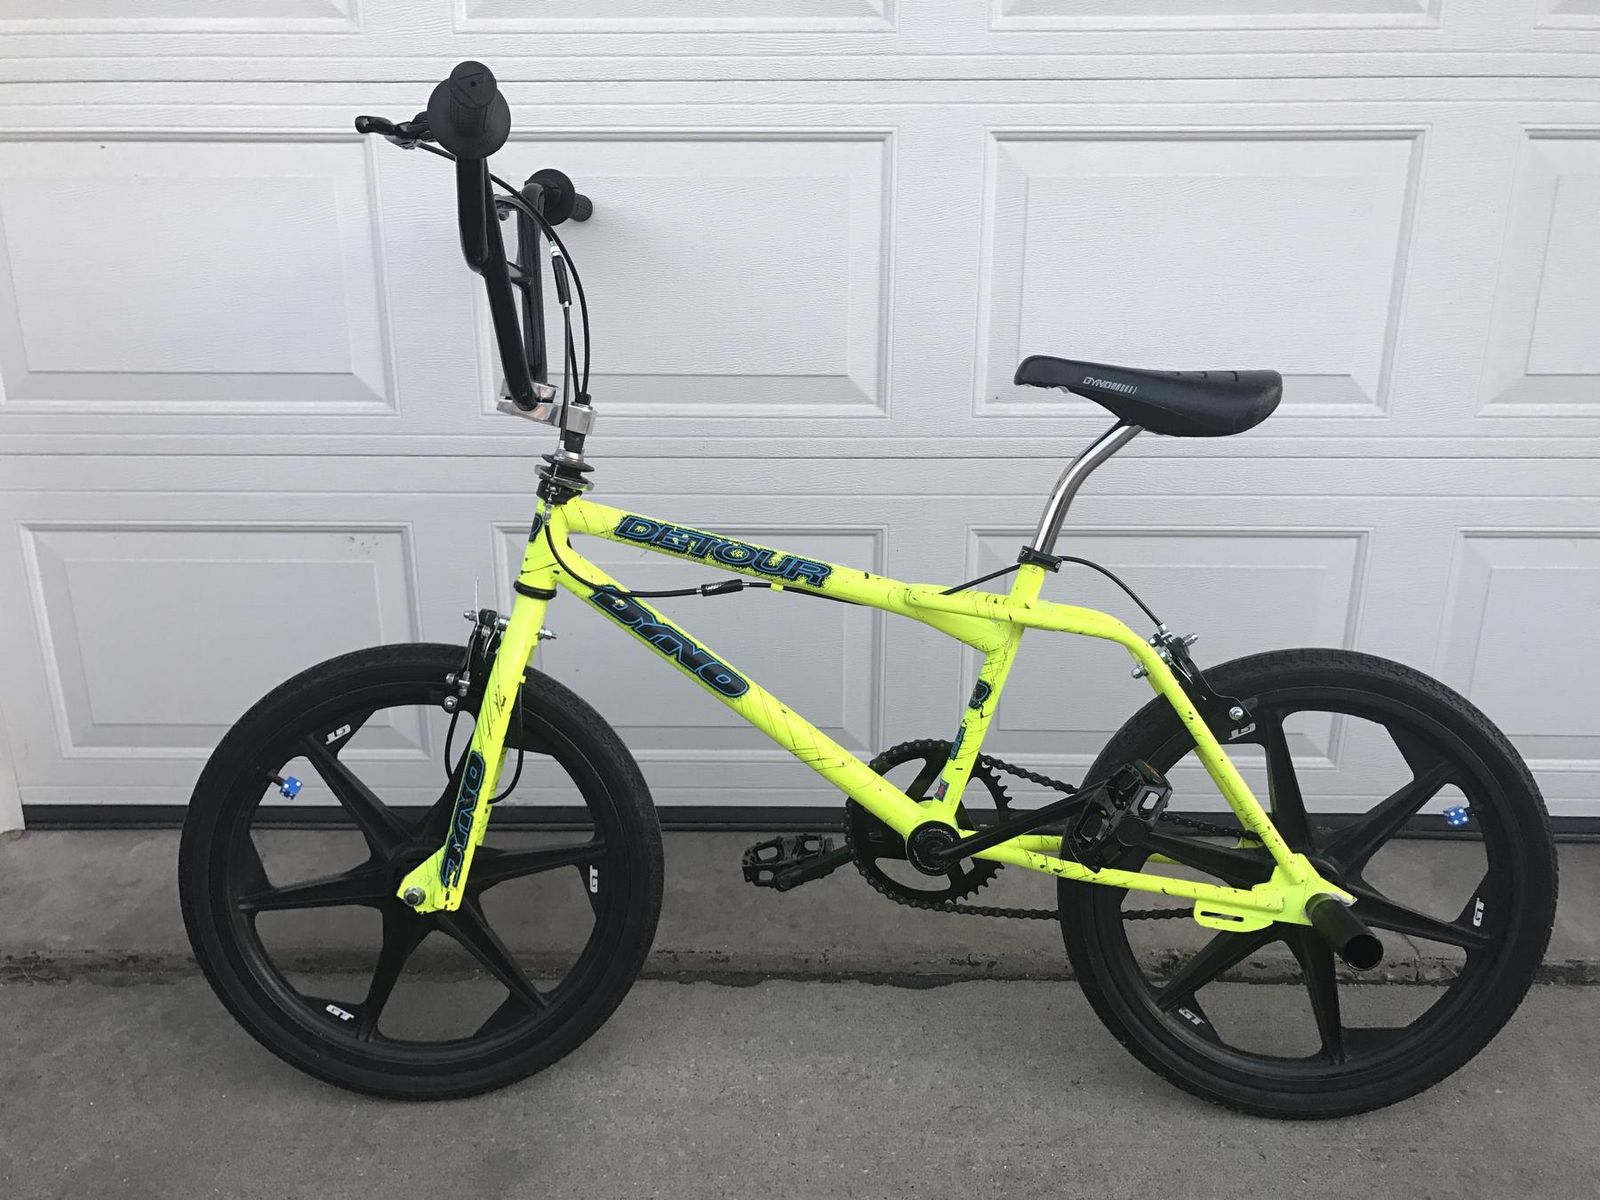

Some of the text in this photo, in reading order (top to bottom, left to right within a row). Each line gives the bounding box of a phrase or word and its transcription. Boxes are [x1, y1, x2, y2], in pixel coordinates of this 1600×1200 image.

[615, 515, 832, 586] DETOUR
[590, 585, 749, 697] DYNO
[325, 723, 351, 745] GT
[1228, 722, 1256, 741] GT
[589, 864, 598, 893] GT
[1473, 897, 1485, 927] GT
[325, 1003, 355, 1021] GT
[1178, 1008, 1205, 1025] GT
